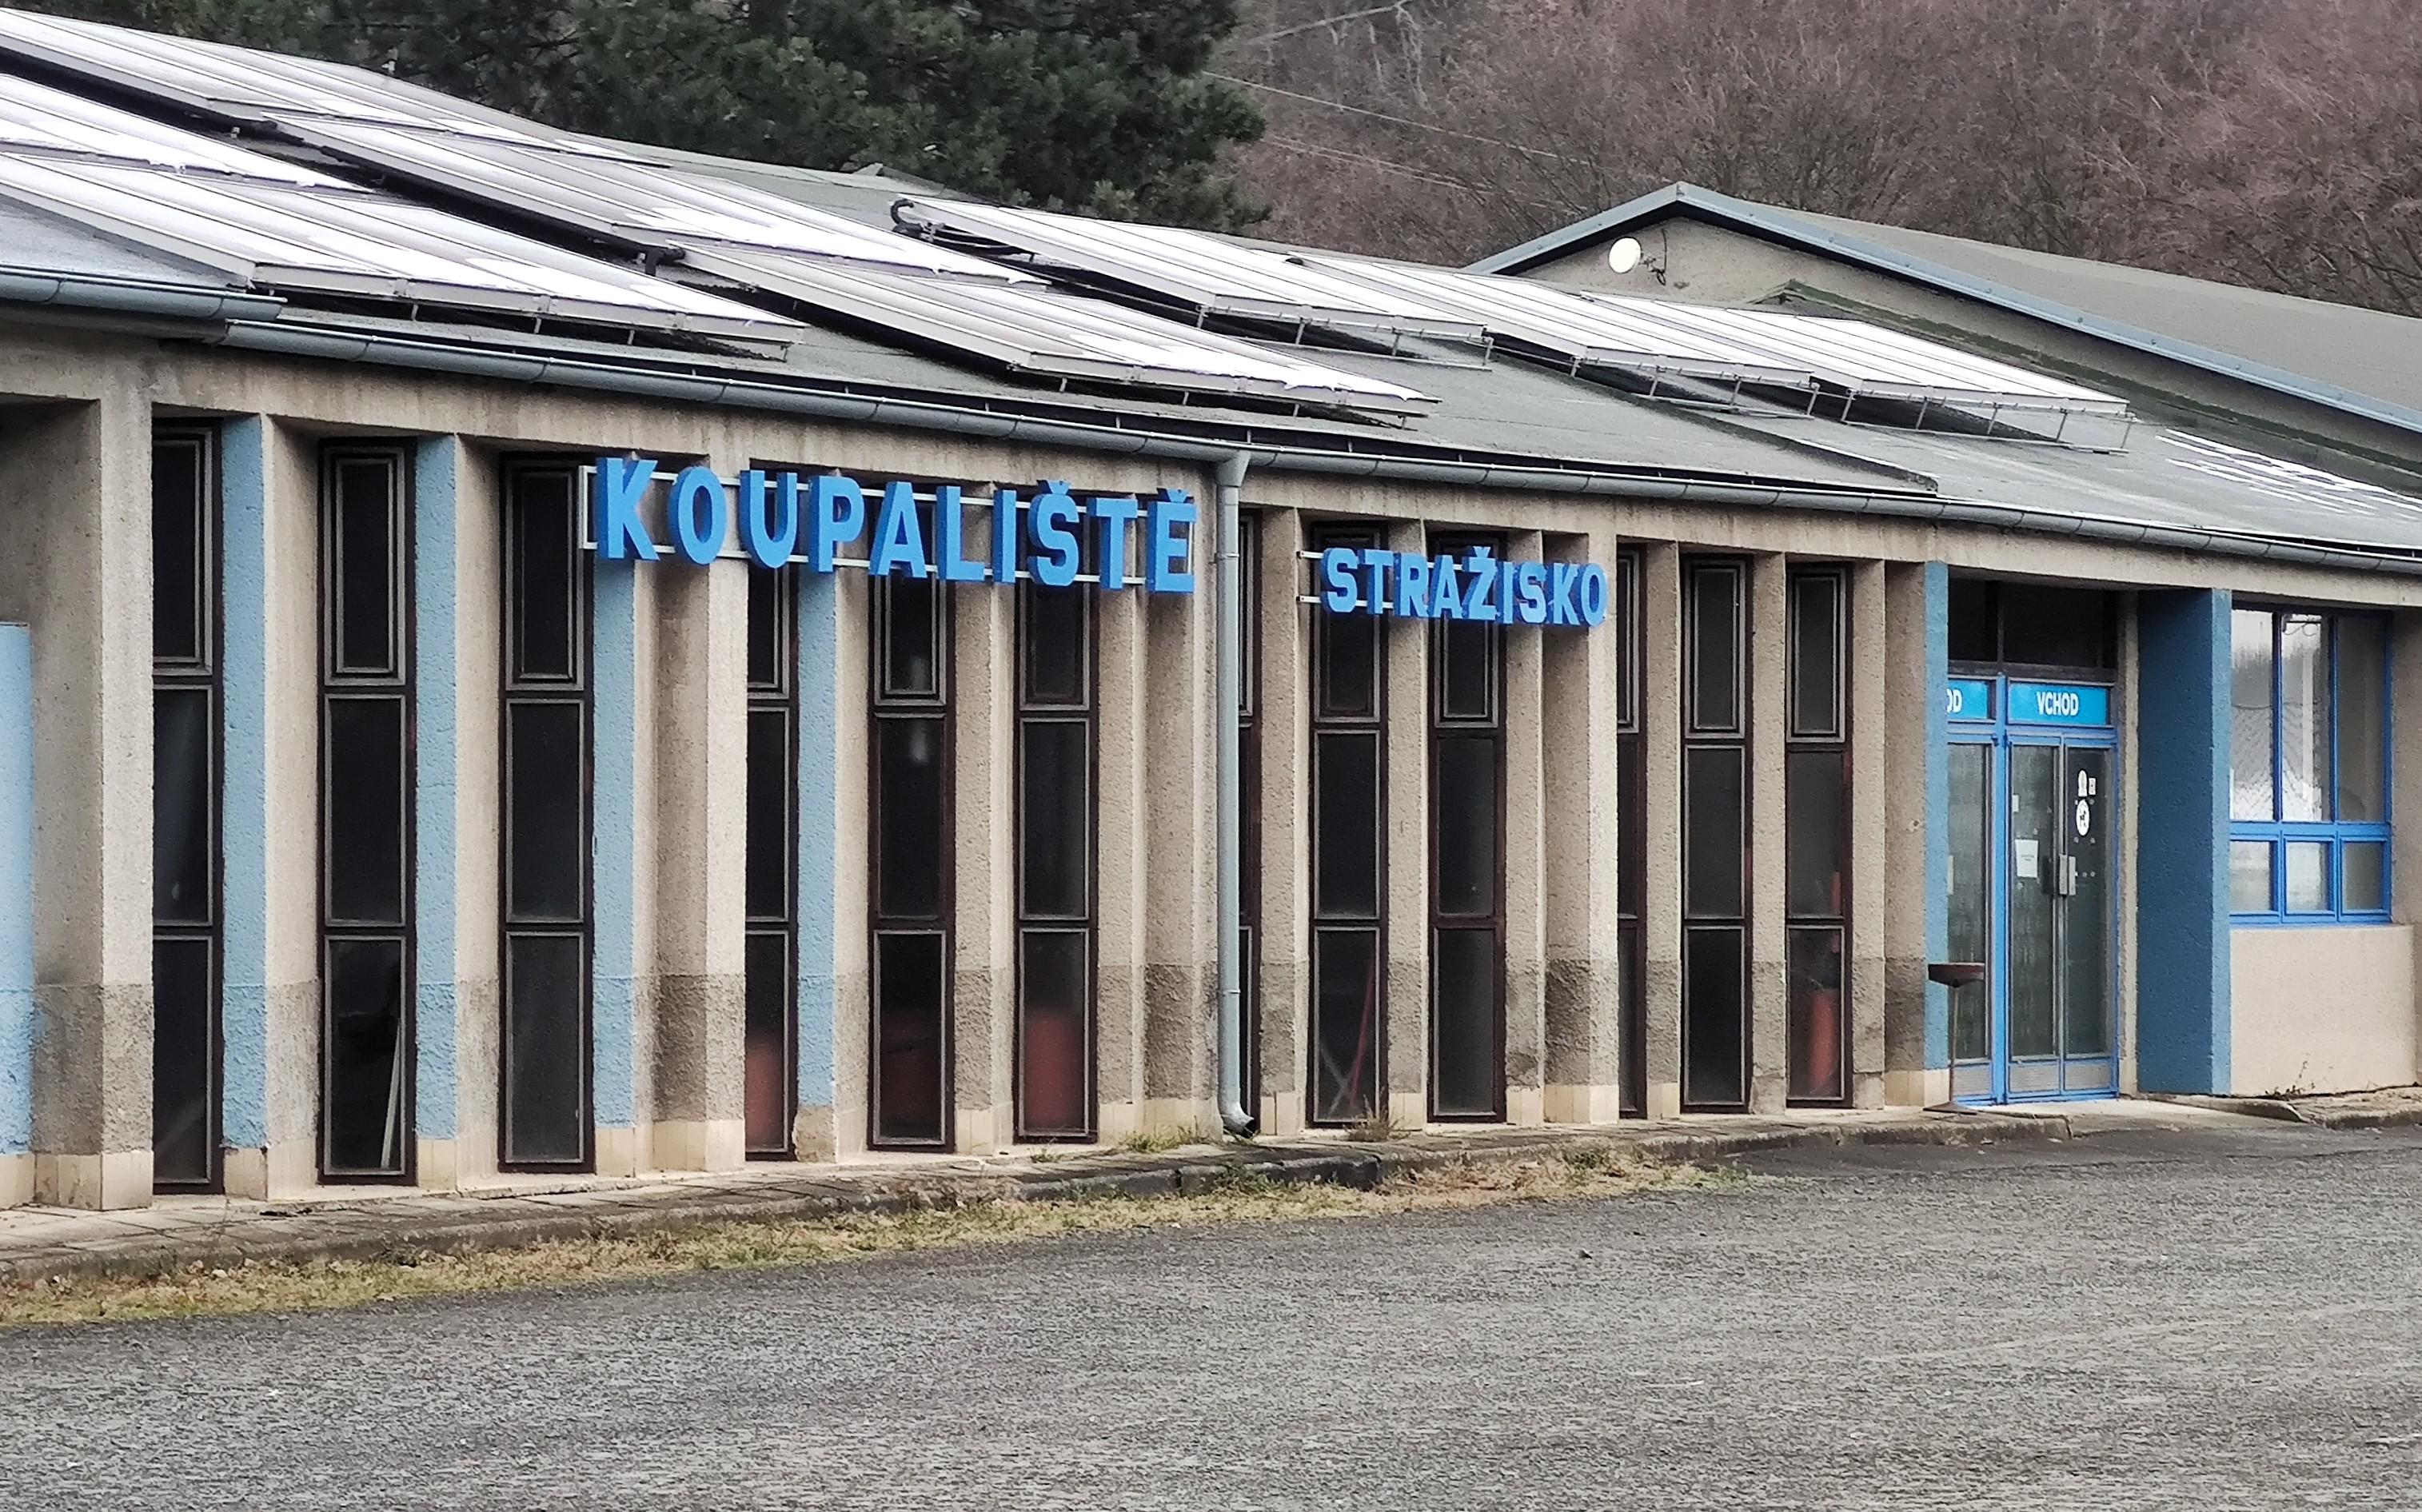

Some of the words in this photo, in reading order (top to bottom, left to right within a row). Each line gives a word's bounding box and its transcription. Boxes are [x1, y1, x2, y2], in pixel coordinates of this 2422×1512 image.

[597, 457, 1196, 592] KOUPALIŠTĚ
[1321, 547, 1608, 627] STRAŽISKO
[2037, 691, 2079, 716] VCHOD
